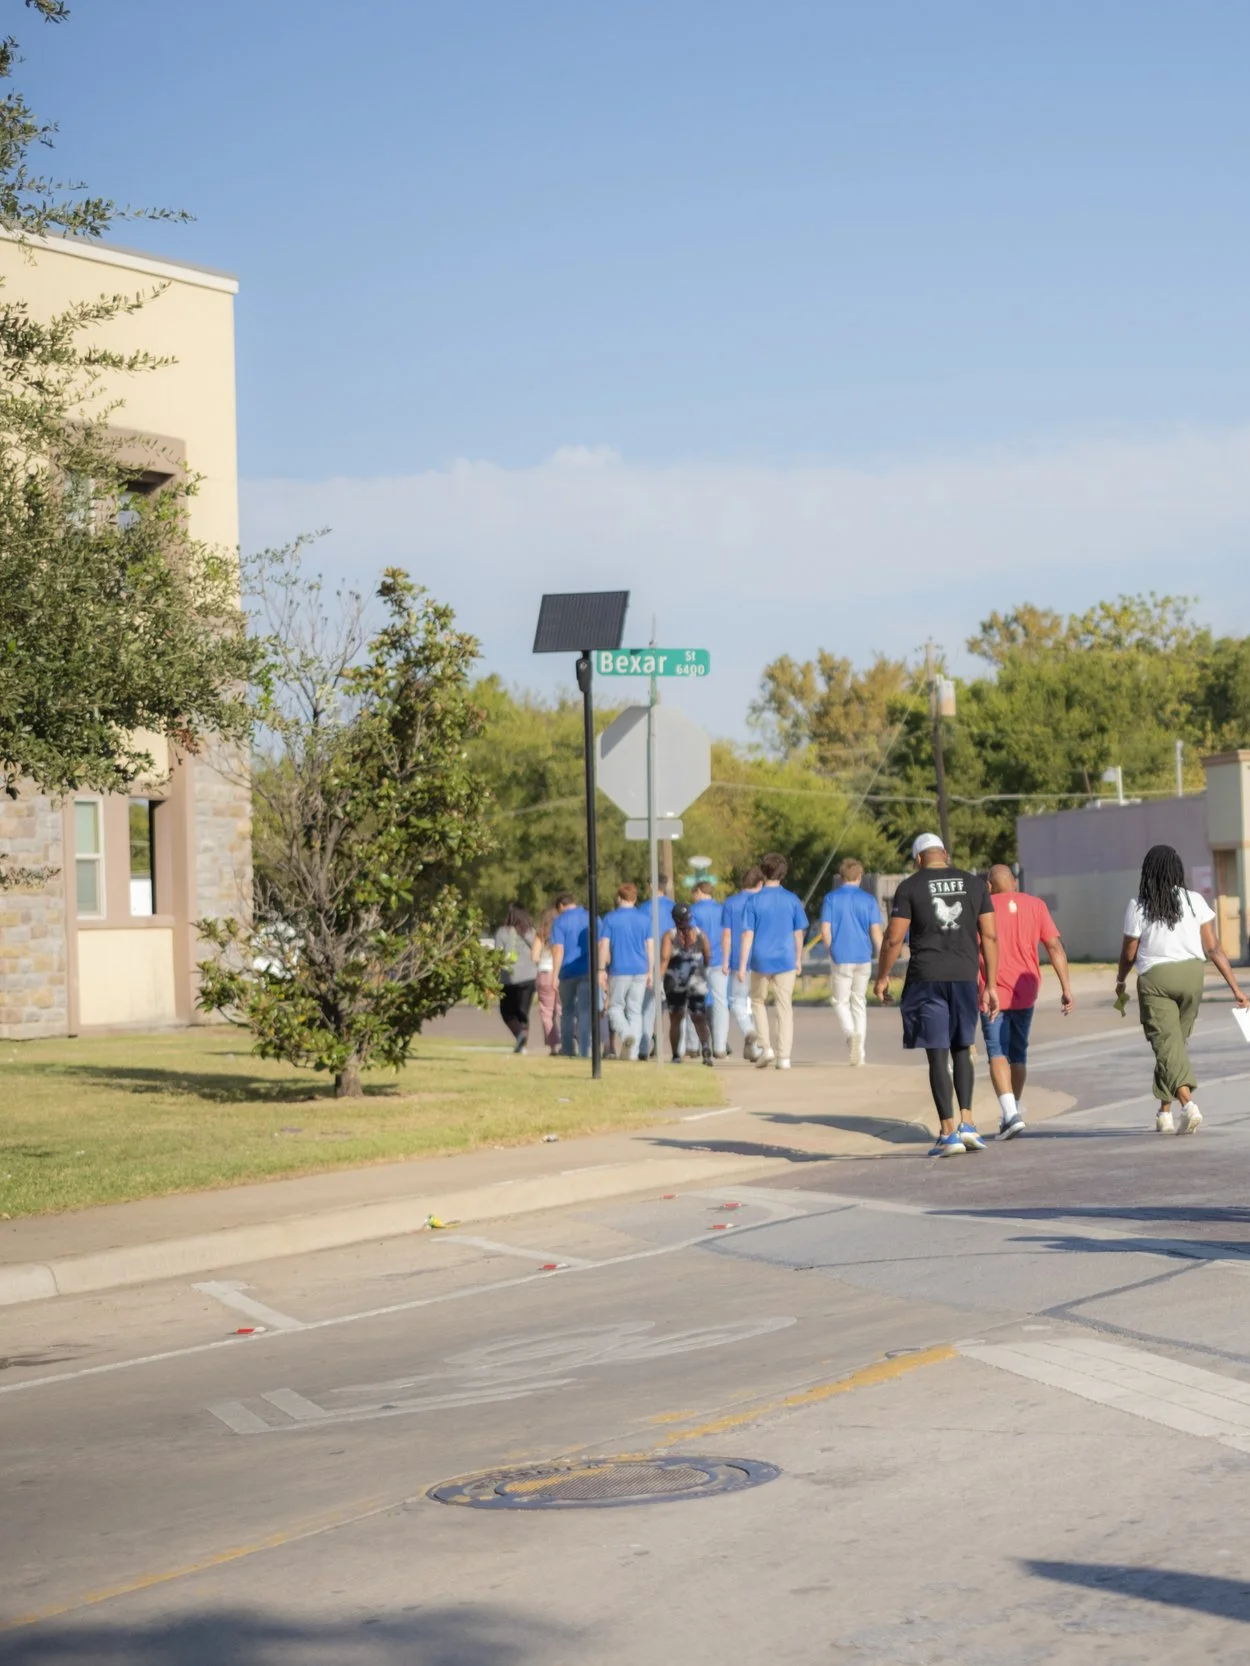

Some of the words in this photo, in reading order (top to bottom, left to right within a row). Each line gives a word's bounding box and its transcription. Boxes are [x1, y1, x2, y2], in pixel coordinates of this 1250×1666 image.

[601, 651, 667, 674] Bexar
[684, 650, 697, 662] St
[676, 663, 705, 675] 6400
[929, 881, 964, 893] STAFF
